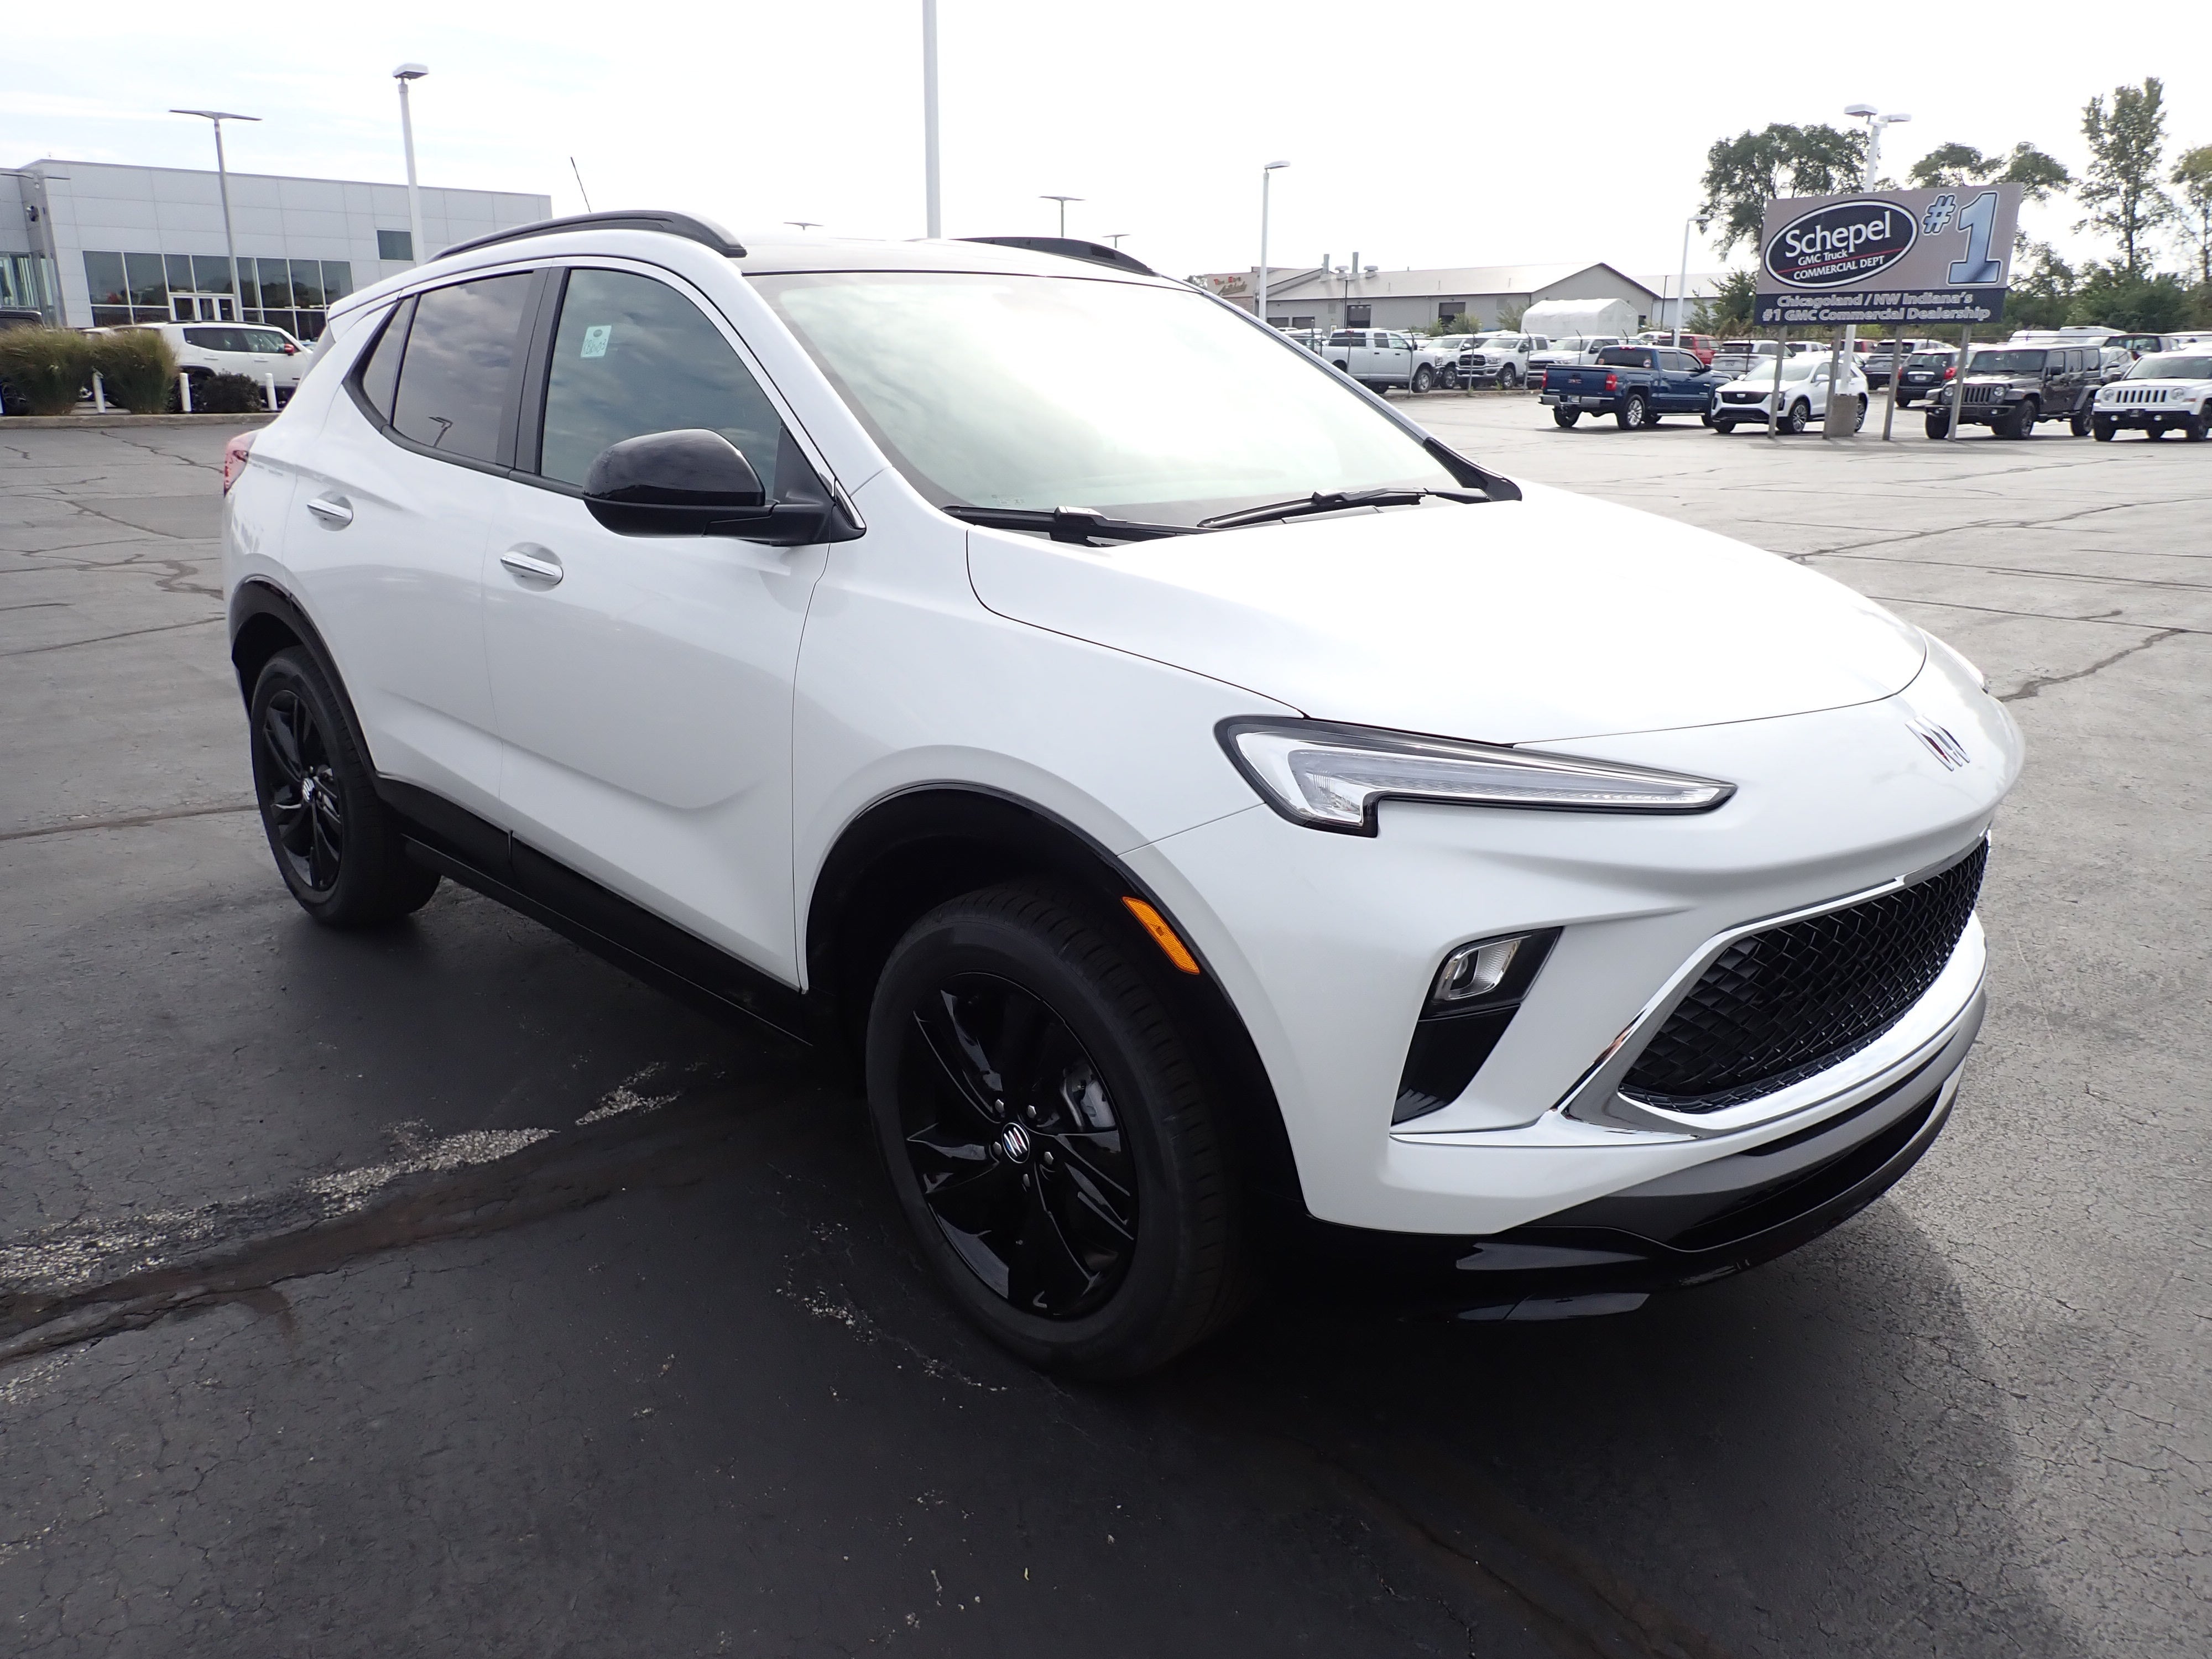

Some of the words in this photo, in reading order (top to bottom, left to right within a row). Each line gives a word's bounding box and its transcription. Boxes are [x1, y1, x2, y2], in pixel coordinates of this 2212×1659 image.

[1785, 211, 1891, 257] Schepel
[1922, 191, 2002, 286] #1
[1793, 262, 1858, 280] COMMERCIAL
[1860, 255, 1885, 268] DEPT
[1798, 253, 1822, 266] GMC
[1823, 250, 1848, 261] Truck
[1777, 294, 1863, 309] Chicagoland
[1873, 293, 1901, 305] NW
[1902, 292, 1973, 305] Indiana's
[1762, 309, 1781, 321] #1
[1784, 309, 1818, 321] GMC
[1819, 307, 1905, 321] Commercial
[1907, 306, 1991, 321] Dealership
